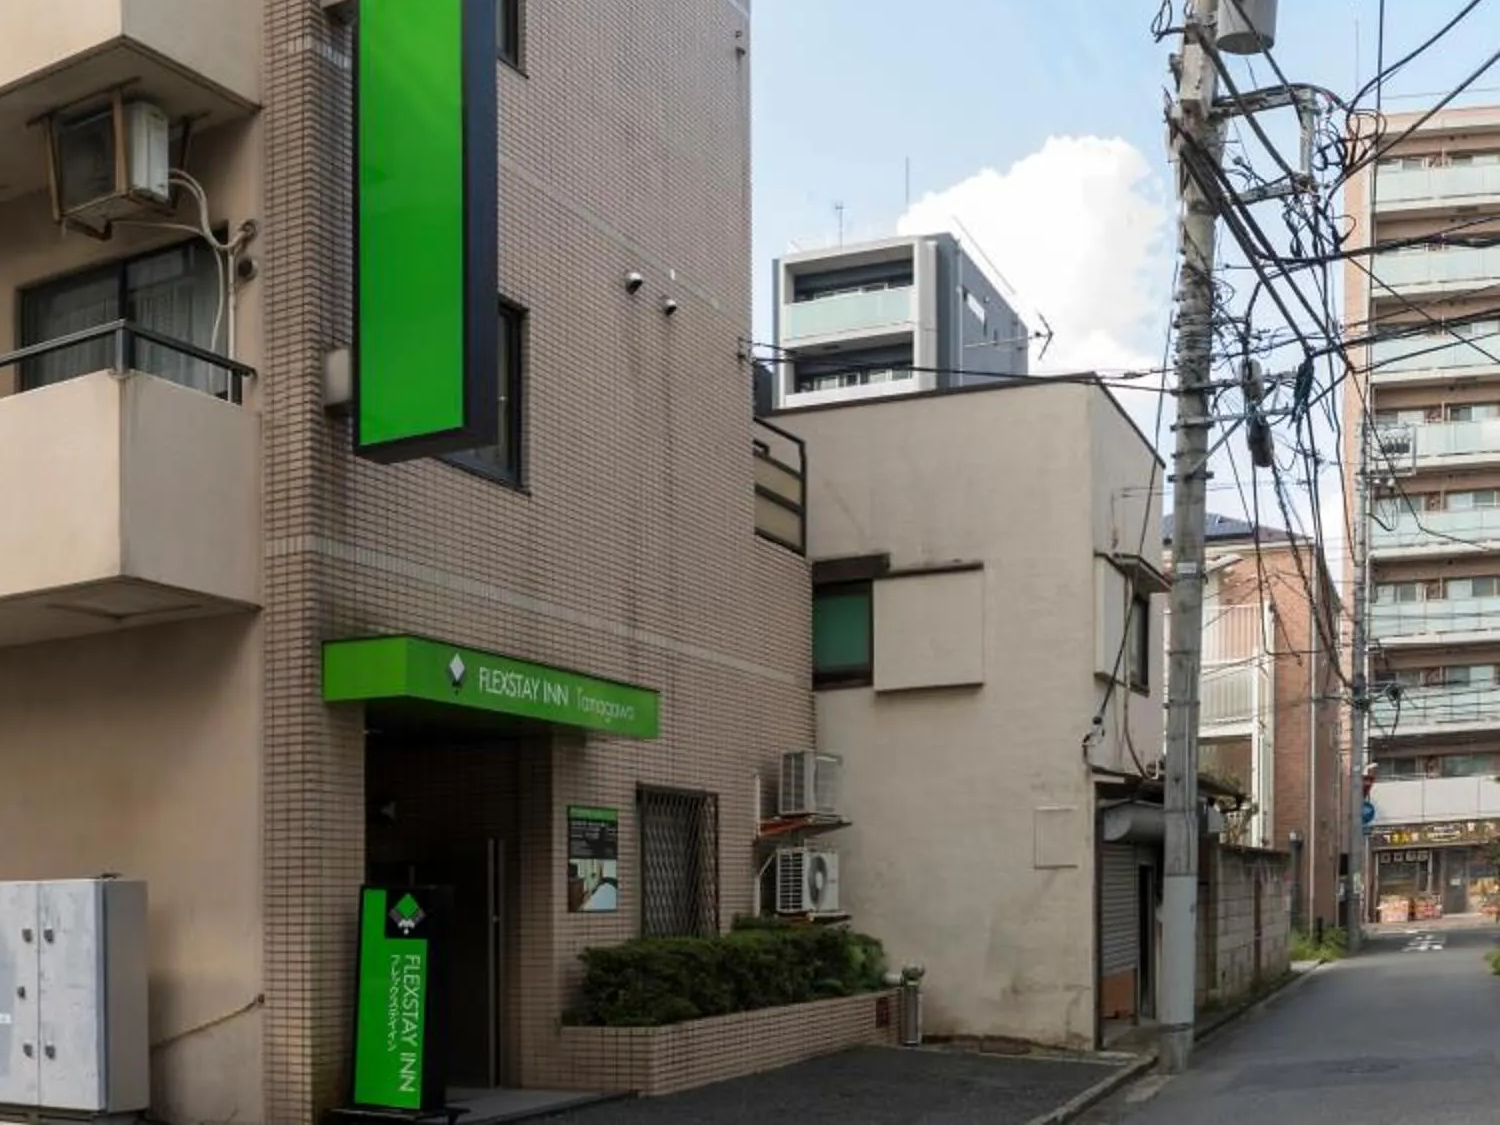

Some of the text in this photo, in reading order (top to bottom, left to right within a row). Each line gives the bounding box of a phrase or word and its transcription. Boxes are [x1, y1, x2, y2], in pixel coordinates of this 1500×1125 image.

[478, 666, 540, 702] FLEXSTAY
[543, 679, 569, 706] INN
[399, 954, 420, 1092] FLEXSTAY INN
